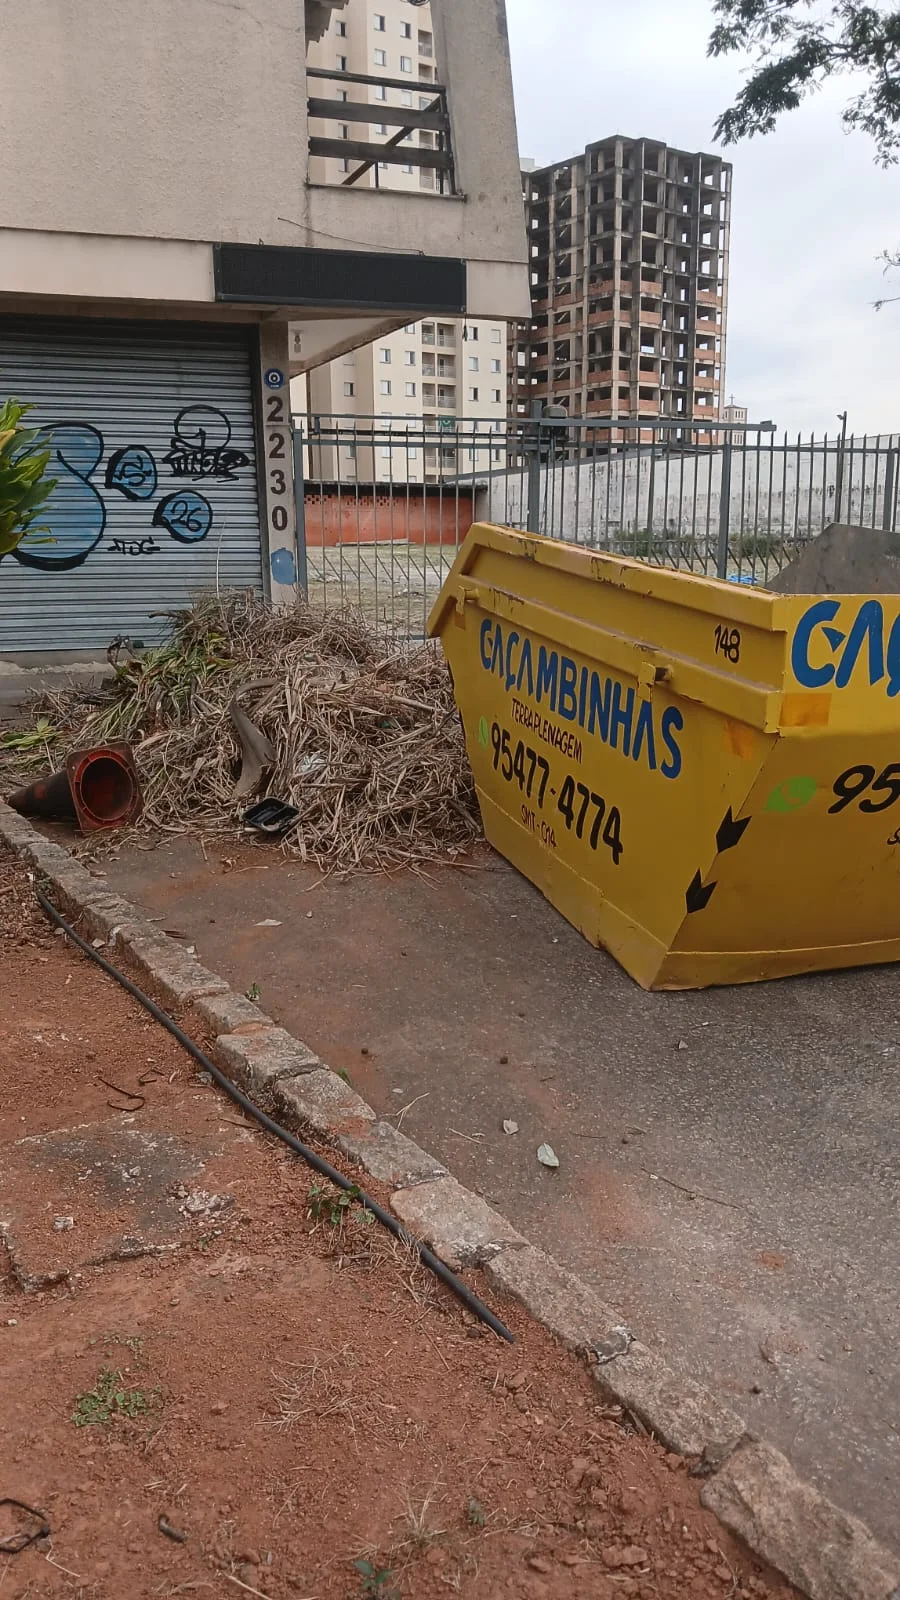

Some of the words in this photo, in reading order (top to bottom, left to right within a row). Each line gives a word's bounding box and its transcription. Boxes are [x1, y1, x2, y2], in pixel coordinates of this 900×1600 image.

[266, 396, 288, 531] 2230
[714, 623, 741, 664] 148
[512, 697, 582, 765] TERRAPLENAGEM
[491, 722, 623, 865] 95477-4774
